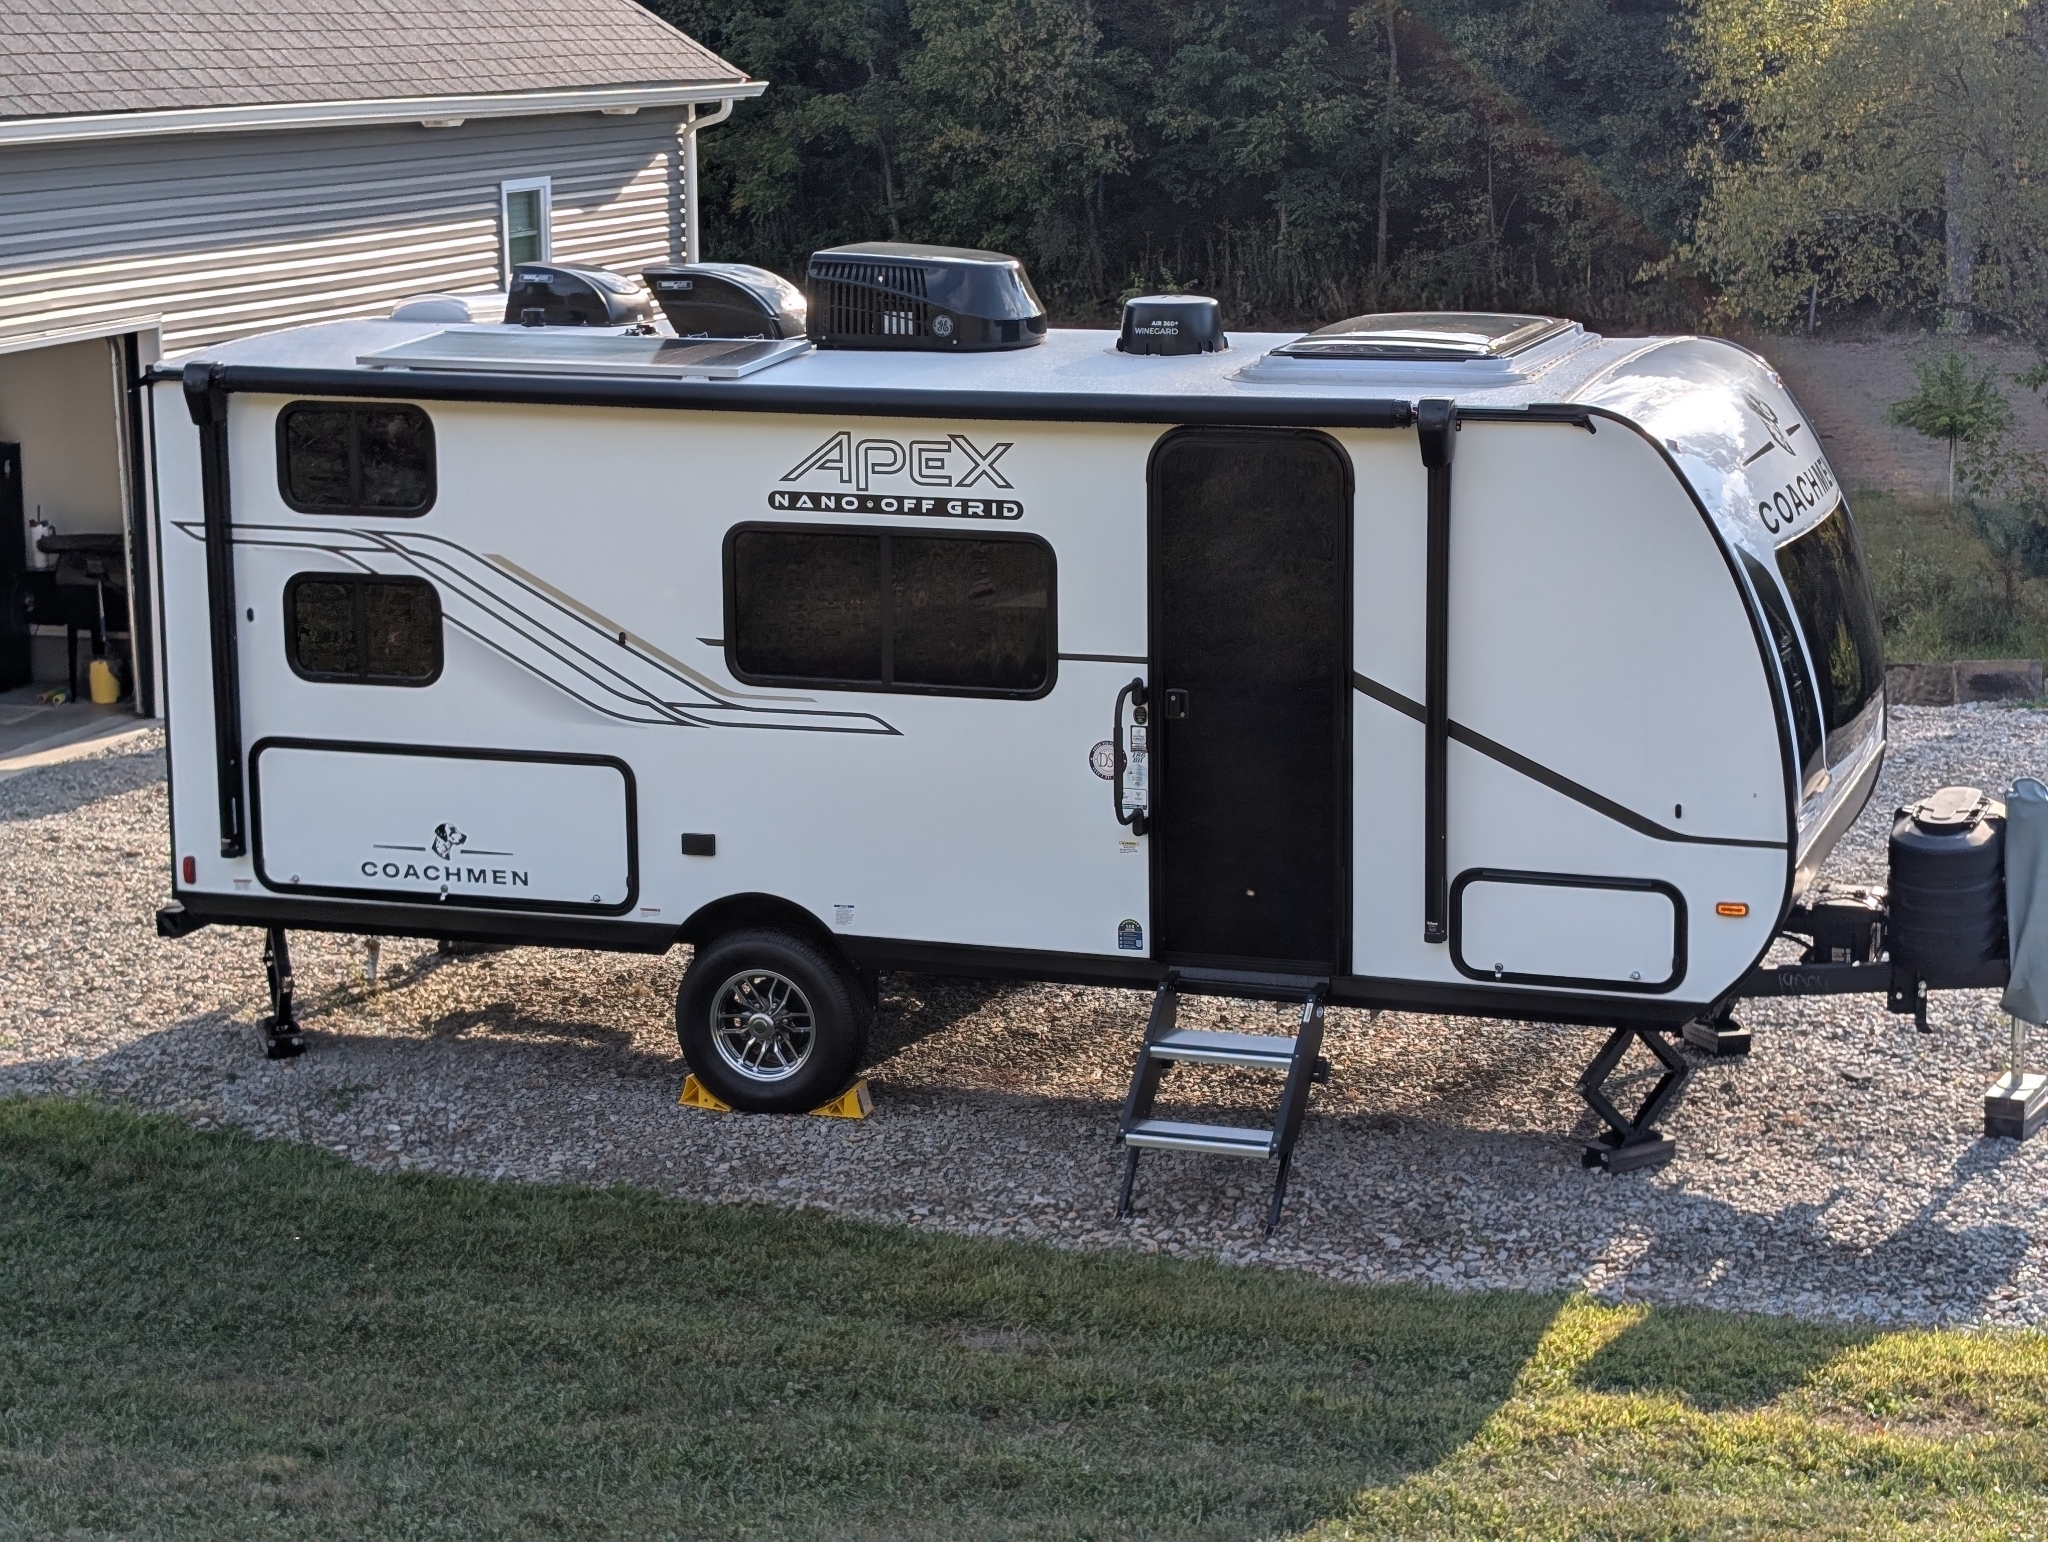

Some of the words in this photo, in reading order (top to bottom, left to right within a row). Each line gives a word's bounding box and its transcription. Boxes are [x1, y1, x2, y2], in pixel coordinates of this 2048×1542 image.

[1134, 327, 1179, 335] WINEGARD
[778, 430, 1015, 492] APEX
[774, 494, 859, 510] NANO
[880, 497, 934, 513] OFF
[946, 501, 1020, 518] GRID
[361, 861, 530, 887] COACHMEN
